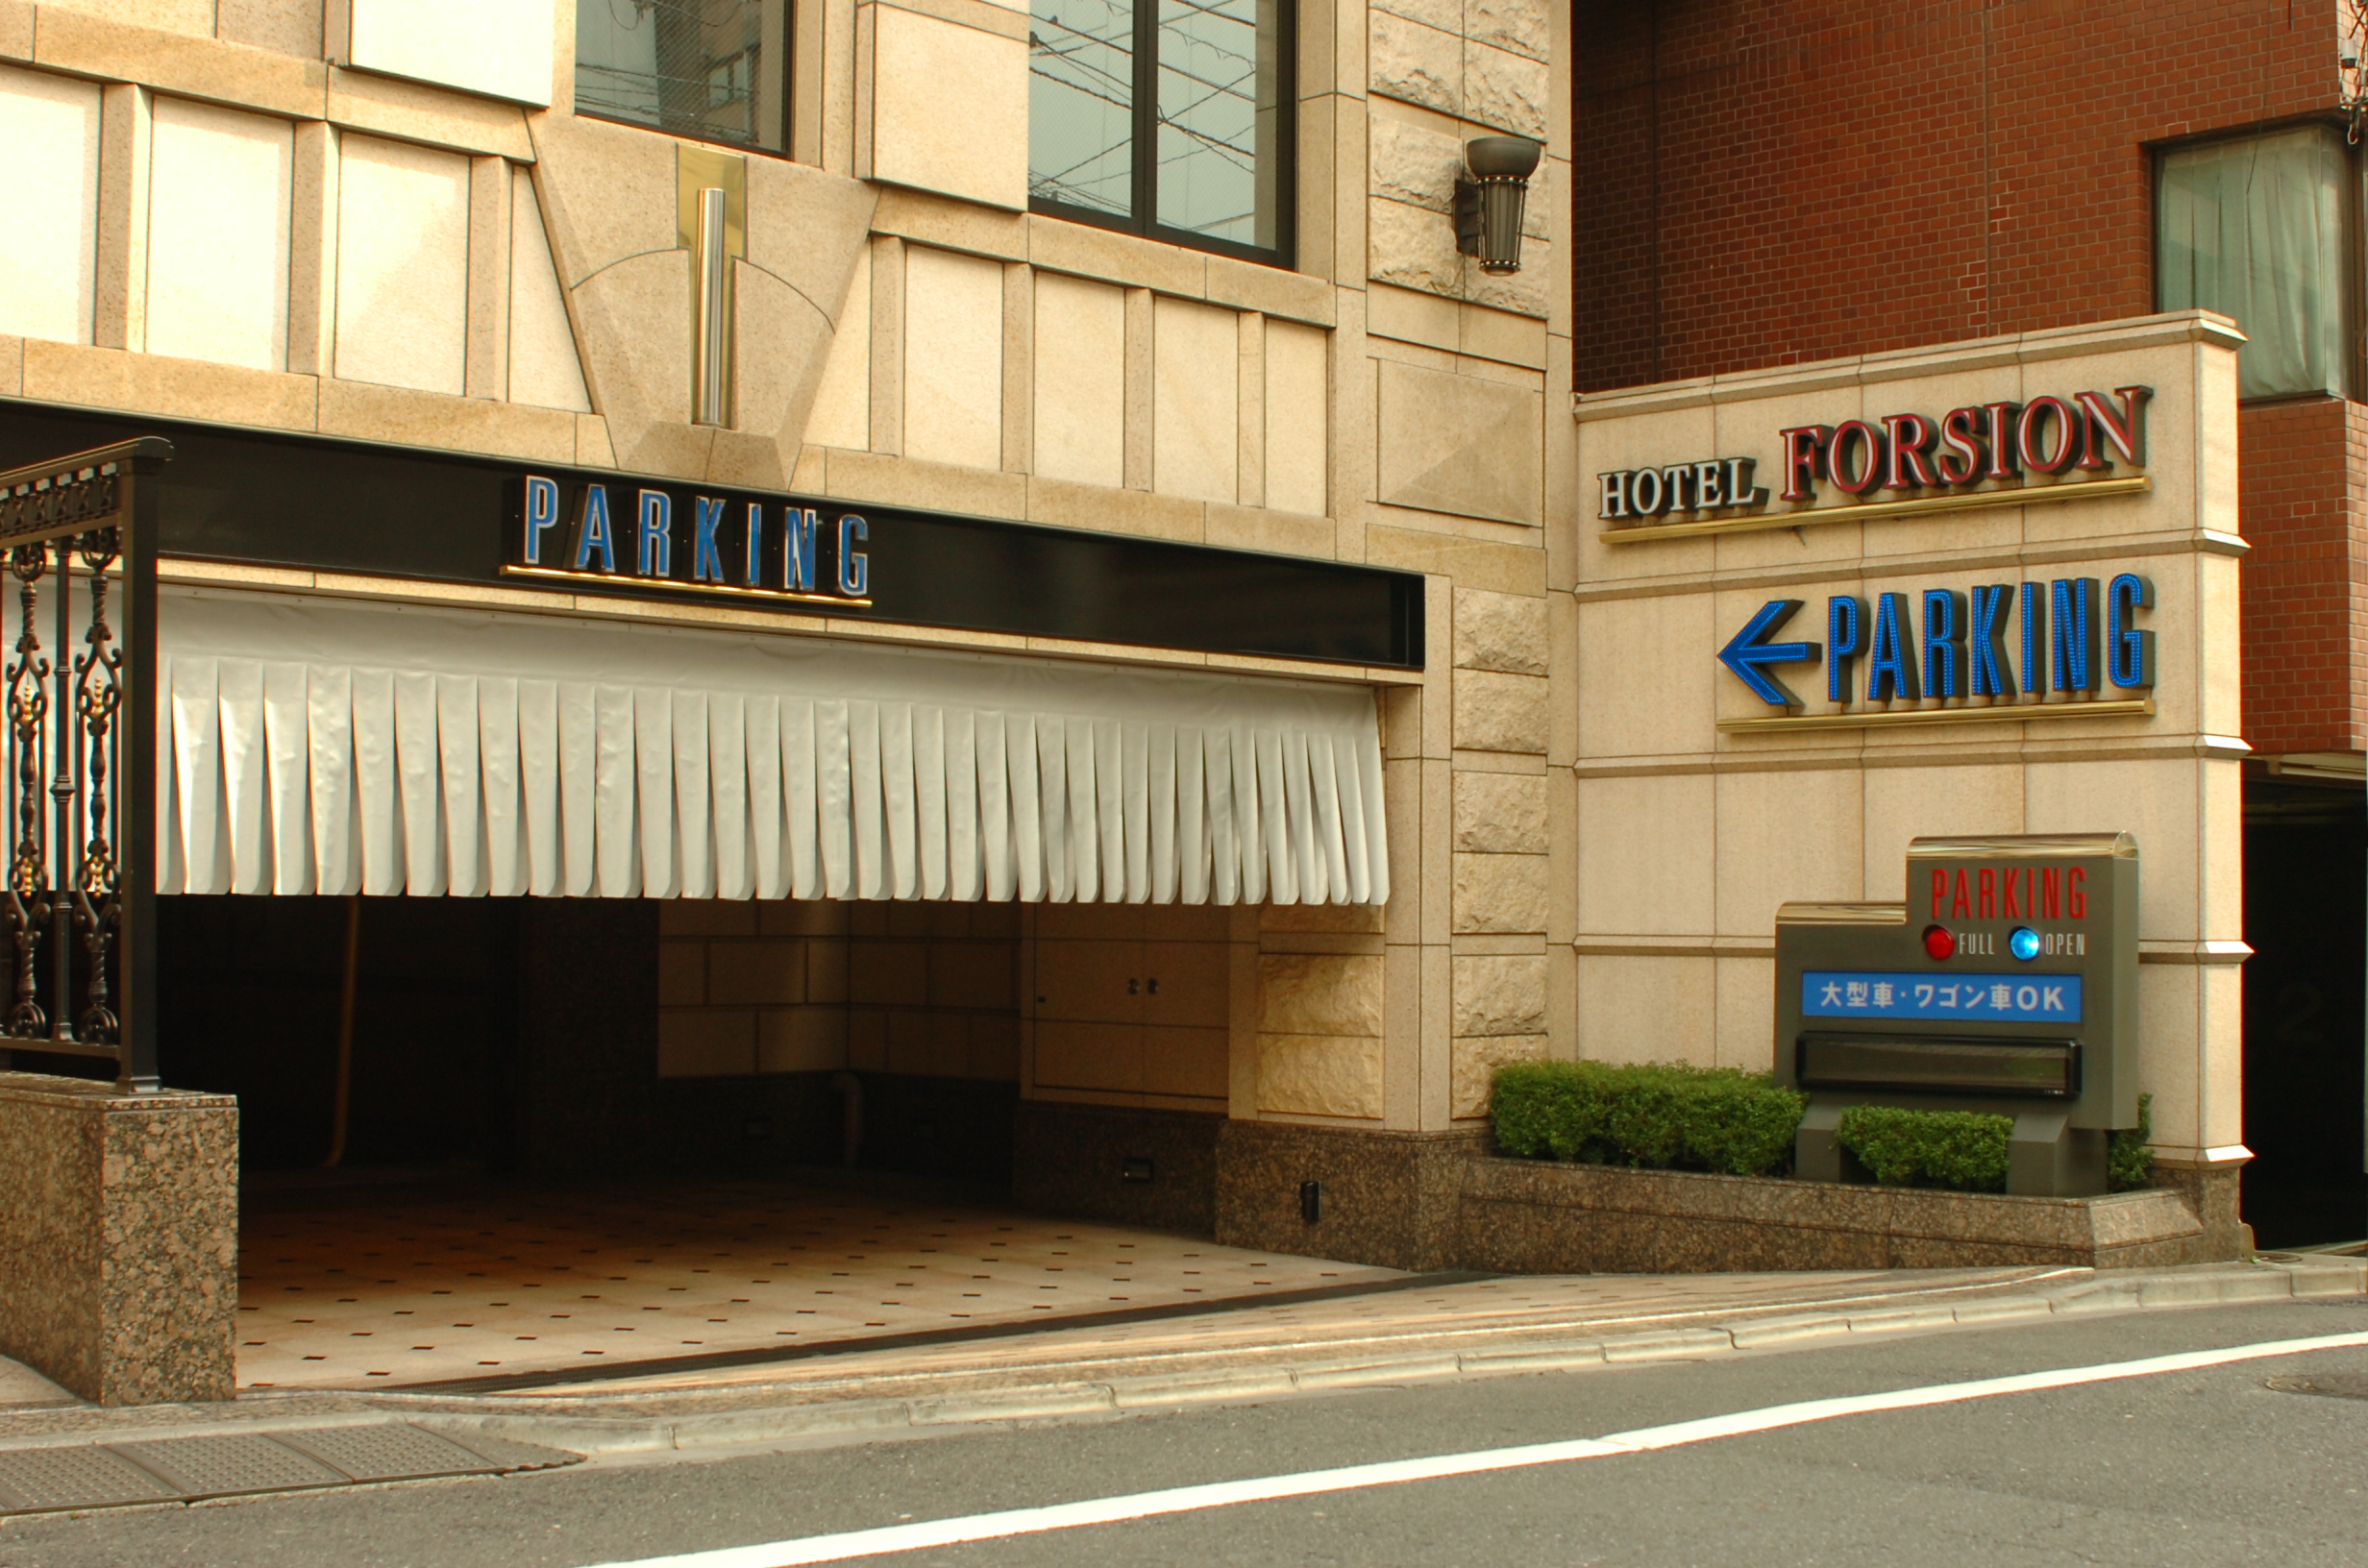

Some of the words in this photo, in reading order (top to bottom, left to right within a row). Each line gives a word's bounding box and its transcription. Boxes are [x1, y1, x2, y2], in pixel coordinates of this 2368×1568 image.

[1597, 456, 1766, 521] HOTEL
[1779, 385, 2154, 502] FORSION
[525, 475, 868, 597] PARKING
[1827, 573, 2155, 703] PARKING
[1932, 867, 2085, 919] PARKING
[1959, 933, 1994, 955] FULL
[2045, 933, 2085, 956] OPEN
